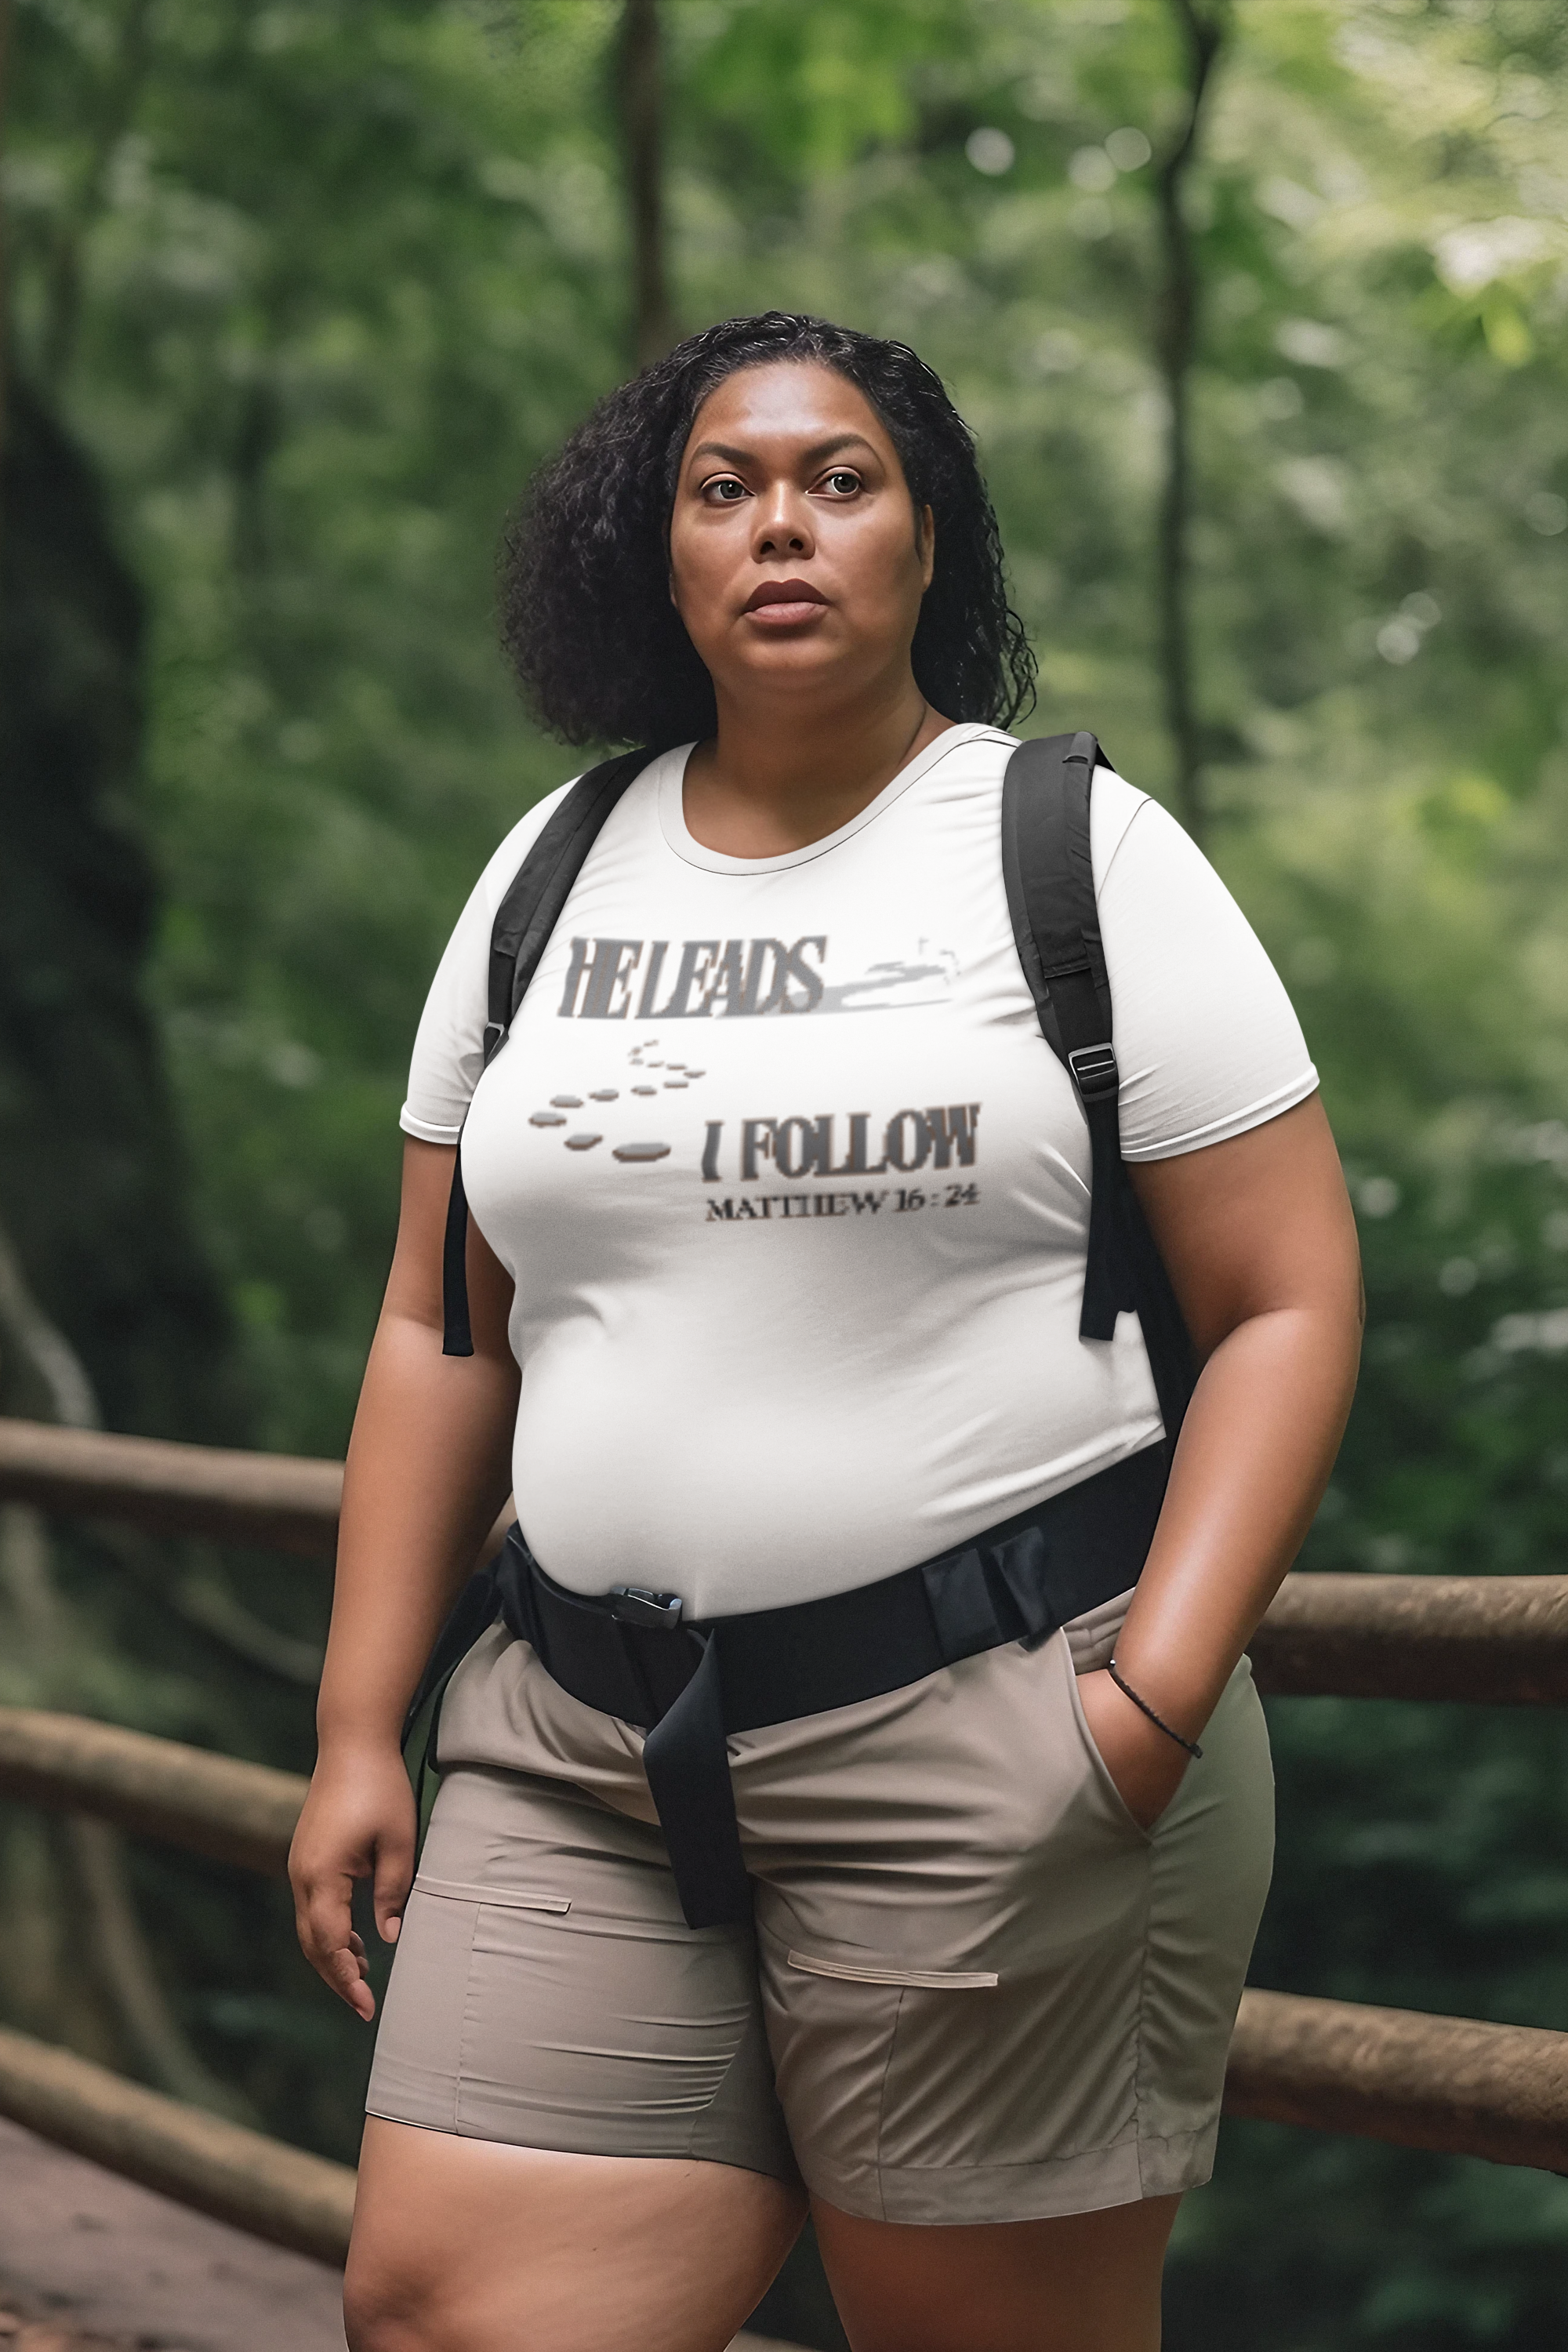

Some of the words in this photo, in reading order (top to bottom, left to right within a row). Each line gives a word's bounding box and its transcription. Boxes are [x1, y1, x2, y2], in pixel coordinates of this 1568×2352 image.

[557, 936, 643, 1019] HE
[634, 935, 828, 1019] LEADS
[702, 1120, 724, 1182] I
[739, 1102, 982, 1181] FOLLOW
[706, 1189, 889, 1221] MATTHEW
